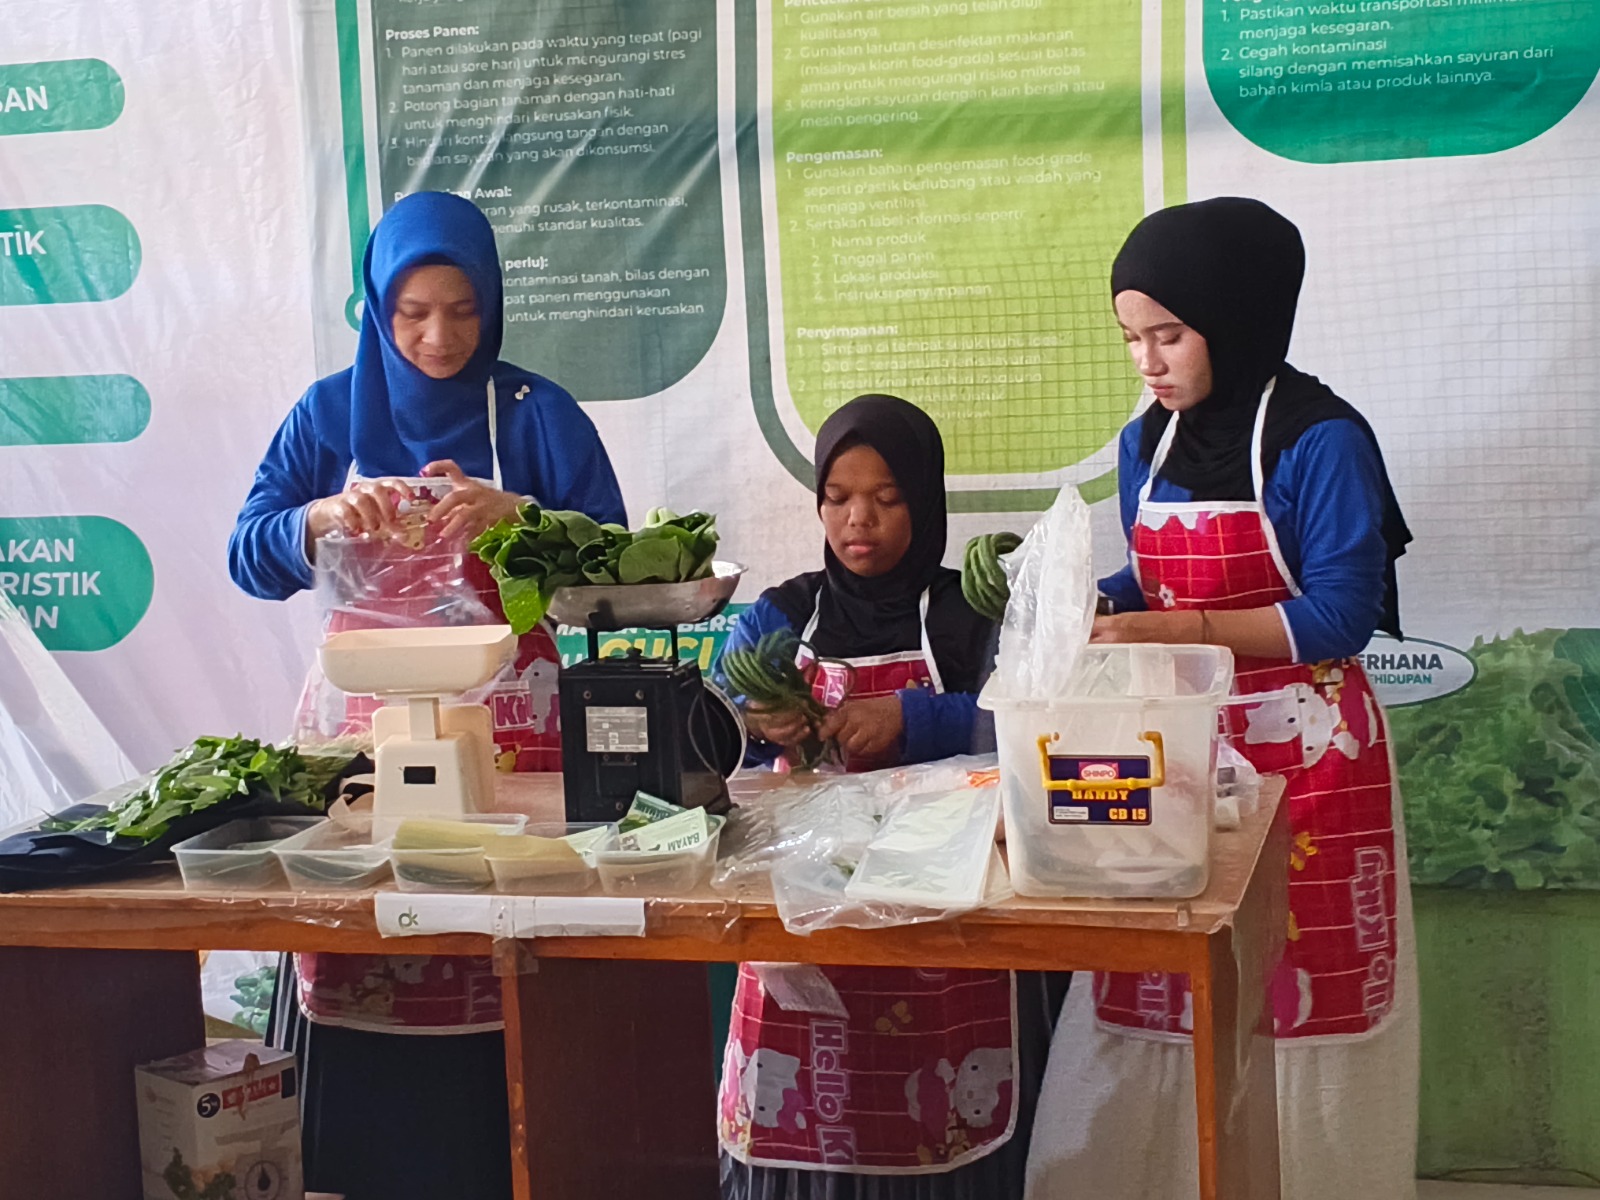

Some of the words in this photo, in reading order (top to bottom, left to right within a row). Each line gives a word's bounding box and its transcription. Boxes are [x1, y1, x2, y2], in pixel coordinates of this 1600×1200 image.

[800, 9, 863, 24] Gunakan
[866, 8, 883, 20] air
[887, 4, 930, 18] bersih
[933, 3, 967, 16] yang
[972, 0, 1008, 12] telah
[1240, 5, 1304, 20] Pastikan
[1308, 1, 1356, 15] waktu
[385, 28, 430, 41] Proses
[433, 26, 480, 38] Panen:
[1239, 25, 1307, 41] menjaga
[1311, 20, 1395, 36] kesegaran.
[402, 46, 442, 58] Panen
[446, 41, 509, 55] dilakukan
[512, 38, 544, 52] pada
[546, 36, 589, 48] waktu
[592, 35, 626, 48] yang
[629, 31, 664, 44] tepat
[668, 28, 702, 43] (pagi
[800, 45, 863, 59] Gunakan
[866, 41, 915, 55] larutan
[919, 33, 1002, 50] desinfektan
[1006, 29, 1074, 44] makanan
[1239, 44, 1288, 61] Cegah
[1292, 38, 1387, 55] kontaminasi
[402, 64, 427, 76] hari
[430, 64, 458, 75] atau
[461, 61, 489, 72] sore
[491, 57, 520, 71] hari)
[524, 54, 563, 68] untuk
[566, 50, 650, 66] mengurangi
[653, 49, 686, 60] stres
[800, 62, 866, 78] (misalnya
[911, 51, 994, 69] food-grade)
[998, 49, 1042, 63] sesuai
[1046, 46, 1086, 59] batas
[1239, 65, 1284, 79] silang
[1287, 60, 1347, 76] dengan
[1351, 54, 1453, 70] memisahkan
[1457, 49, 1519, 66] sayuran
[1523, 45, 1554, 60] dari
[403, 82, 461, 95] tanaman
[464, 79, 489, 90] dan
[492, 75, 549, 91] menjaga
[800, 81, 841, 94] aman
[844, 76, 886, 91] untuk
[889, 68, 976, 88] mengurangi
[979, 67, 1017, 82] risiko
[1020, 63, 1081, 79] mikroba
[1239, 82, 1287, 98] bahan
[1291, 79, 1333, 93] kimia
[1337, 79, 1371, 91] atau
[1376, 73, 1432, 91] produk
[1436, 70, 1495, 86] lainnya.
[0, 85, 49, 113] AN
[404, 101, 450, 113] Potong
[453, 97, 498, 111] bagian
[502, 91, 561, 106] tanaman
[564, 90, 615, 104] dengan
[618, 84, 675, 99] hati-hati
[800, 95, 870, 110] Keringkan
[874, 91, 929, 106] sayuran
[932, 88, 987, 103] dengan
[991, 85, 1020, 98] kain
[1024, 81, 1069, 95] bersih
[1072, 80, 1105, 92] atau
[405, 117, 442, 130] untuk
[446, 112, 530, 129] menghindari
[534, 108, 601, 122] kerusakan
[800, 114, 843, 128] mesin
[405, 135, 452, 149] Hinri
[455, 133, 496, 146] konta
[501, 127, 564, 143] angsung
[617, 123, 668, 138] dengan
[407, 153, 450, 167] bgan
[507, 150, 539, 163] yang
[542, 146, 573, 159] akan
[786, 148, 884, 165] Pengemasan:
[803, 166, 865, 180] Gunakan
[868, 162, 912, 176] bahan
[916, 156, 1009, 174] pengemasan
[1012, 151, 1092, 168] food-grade
[804, 183, 851, 197] seperti
[903, 175, 976, 192] berlubang
[979, 174, 1011, 187] atau
[1066, 169, 1102, 184] yang
[509, 204, 541, 218] yang
[544, 200, 583, 213] rusak,
[586, 196, 688, 212] terkontaminasi,
[805, 200, 866, 215] menjaga
[538, 219, 587, 232] standar
[805, 216, 867, 231] Sertakan
[832, 236, 873, 248] Nama
[876, 232, 927, 248] produk
[505, 256, 548, 272] perlu):
[833, 252, 887, 268] Tanggal
[503, 273, 578, 288] ontaminasi
[581, 270, 623, 284] tanah,
[625, 268, 656, 281] bilas
[658, 267, 710, 282] dengan
[833, 271, 875, 284] Lokasi
[529, 293, 571, 305] panen
[573, 286, 671, 302] menggunakan
[507, 309, 546, 322] untuk
[549, 305, 633, 322] menghindari
[636, 302, 705, 316] kerusakan
[796, 324, 898, 340] Penyimpanan:
[1131, 808, 1147, 820] 15
[667, 832, 701, 852] BAYAM
[809, 1018, 849, 1124] Hello
